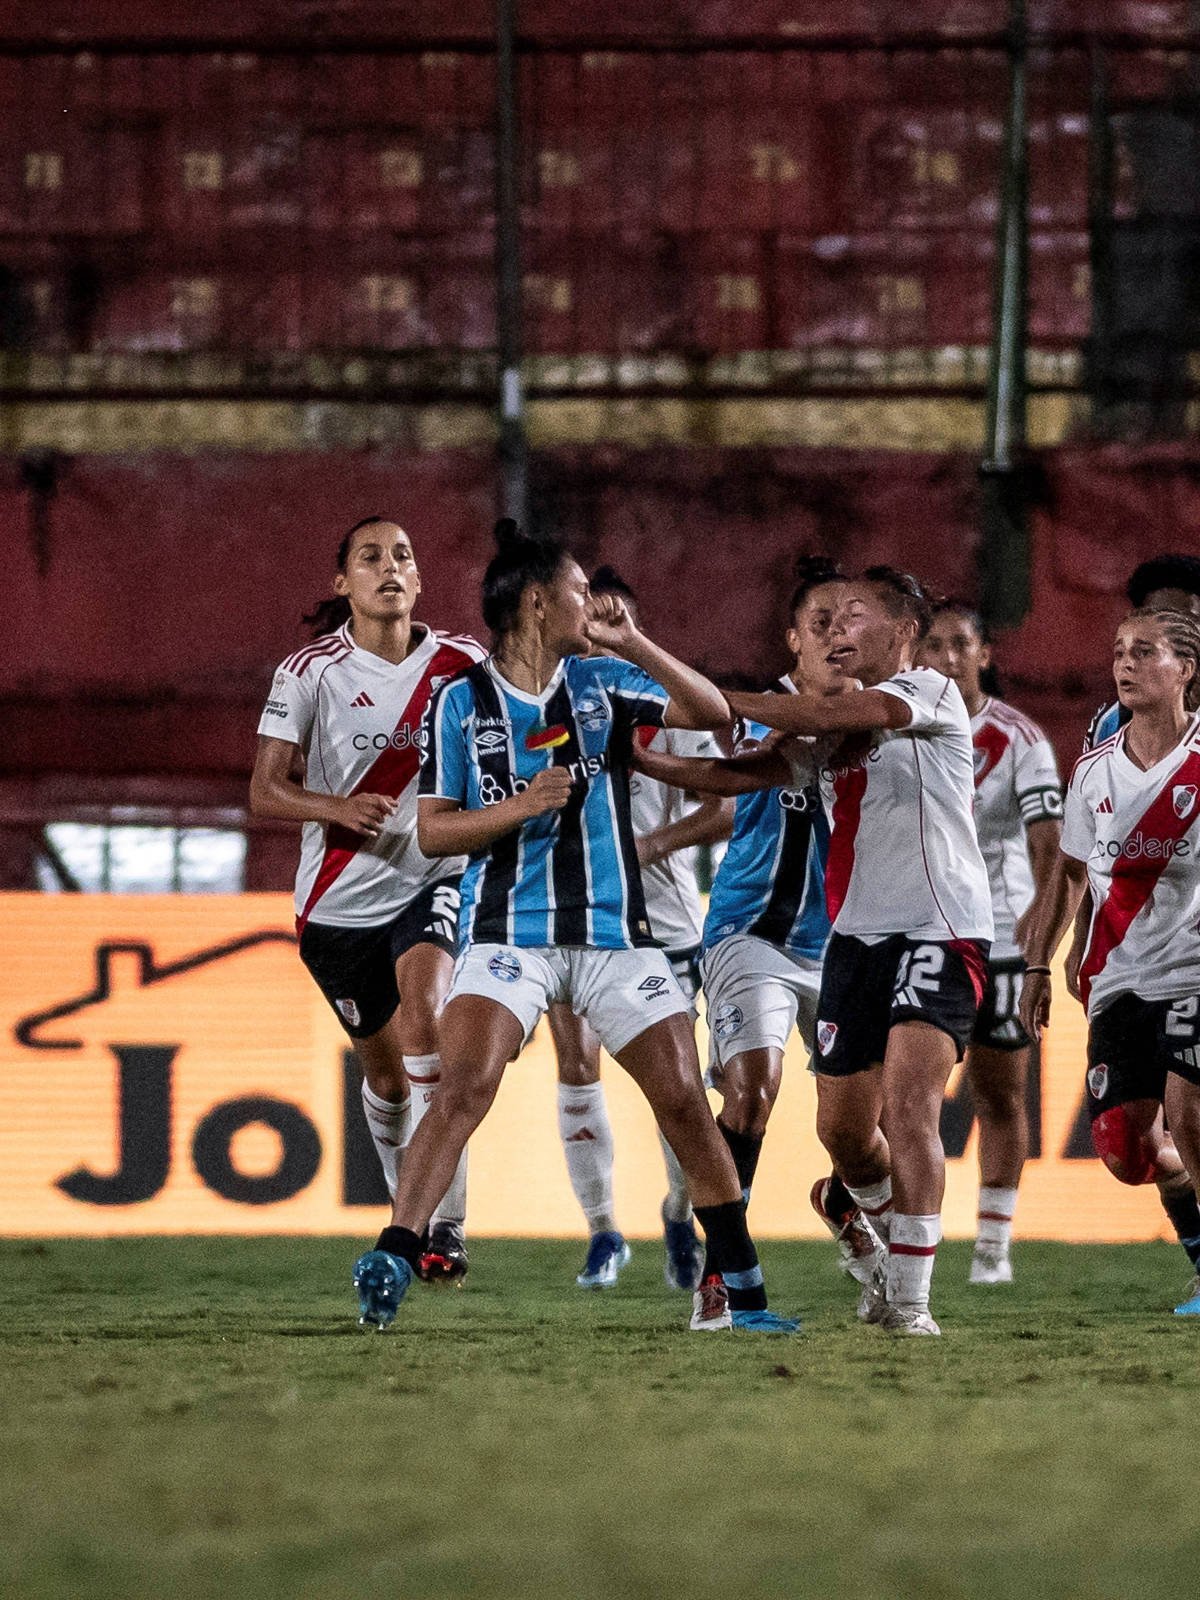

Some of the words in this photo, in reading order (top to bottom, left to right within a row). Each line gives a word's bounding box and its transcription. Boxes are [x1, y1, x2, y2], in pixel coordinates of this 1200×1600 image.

[352, 723, 422, 751] code
[1096, 831, 1190, 859] codere
[645, 987, 670, 1001] umbro
